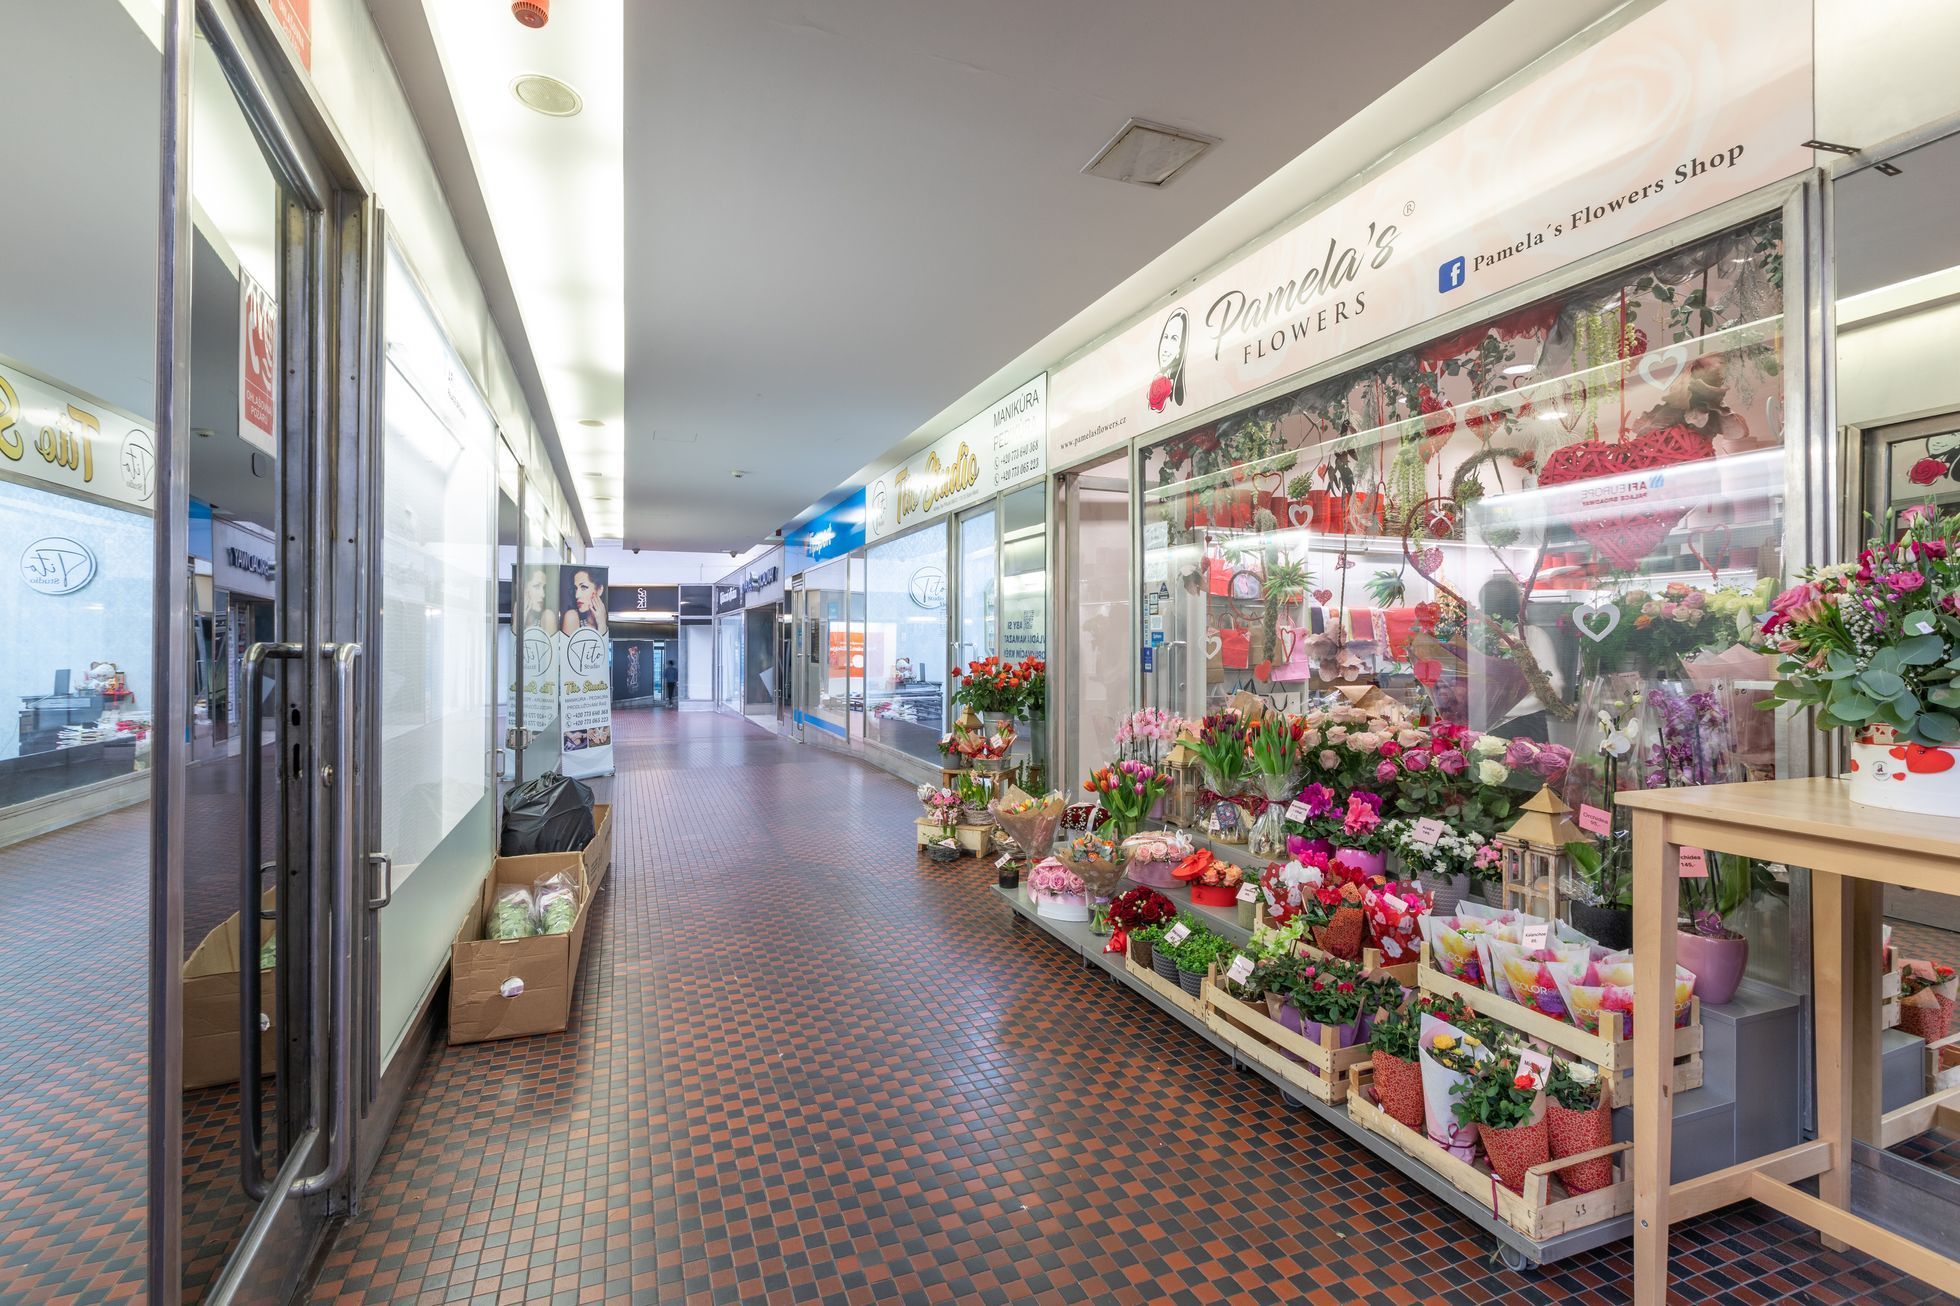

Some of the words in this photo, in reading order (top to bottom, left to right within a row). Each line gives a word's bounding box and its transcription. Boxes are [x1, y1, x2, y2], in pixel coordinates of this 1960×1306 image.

[1570, 178, 1664, 231] Flowers
[1673, 143, 1745, 185] Shop
[1244, 291, 1366, 365] FLOWERS
[993, 389, 1040, 428] MANIKÚRA
[1060, 417, 1127, 449] www.pamelasflowers.cz
[570, 639, 604, 672] Tito
